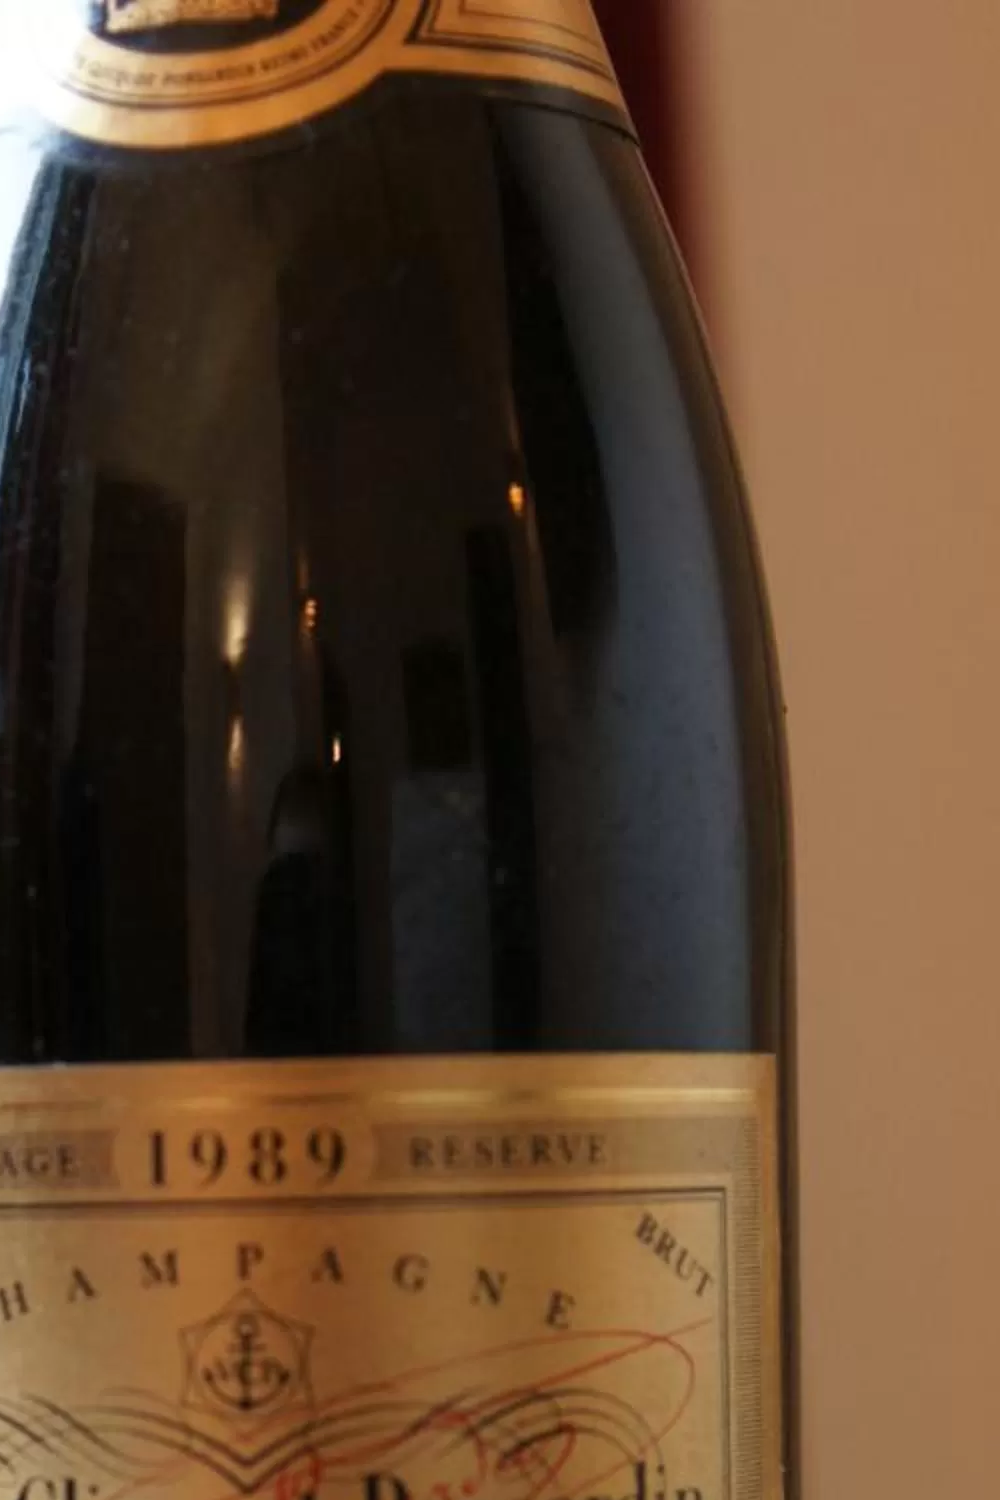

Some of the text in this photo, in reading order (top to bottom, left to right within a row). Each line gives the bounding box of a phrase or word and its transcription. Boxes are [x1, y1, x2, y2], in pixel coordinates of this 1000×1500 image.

[147, 1126, 346, 1188] 1989
[409, 1132, 608, 1171] RESERVE
[634, 1211, 715, 1299] BRUT
